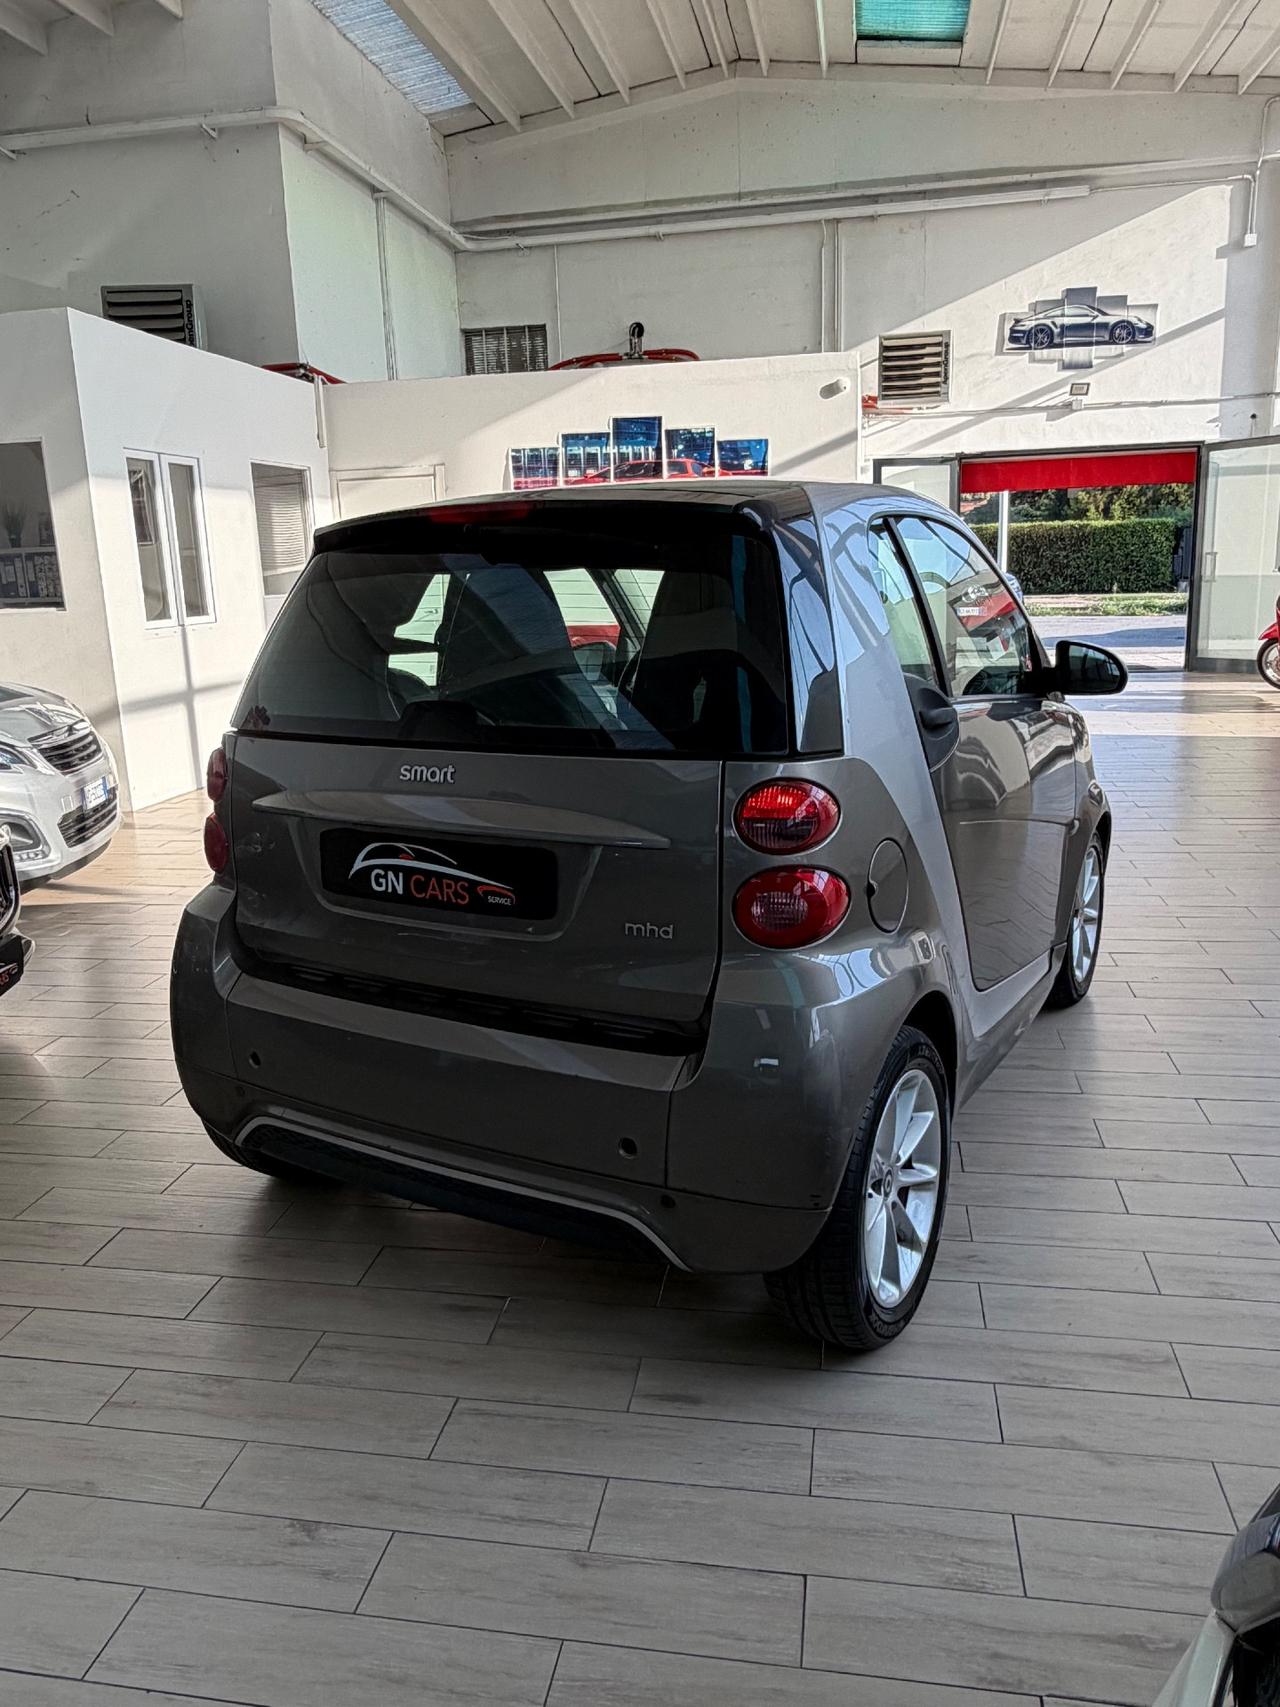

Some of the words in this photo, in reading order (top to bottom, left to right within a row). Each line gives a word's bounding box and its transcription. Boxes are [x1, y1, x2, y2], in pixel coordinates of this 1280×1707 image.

[400, 764, 455, 783] smart
[370, 868, 404, 895] GN
[410, 874, 470, 905] CARS
[487, 895, 512, 906] SERVICE
[625, 922, 673, 939] mhd
